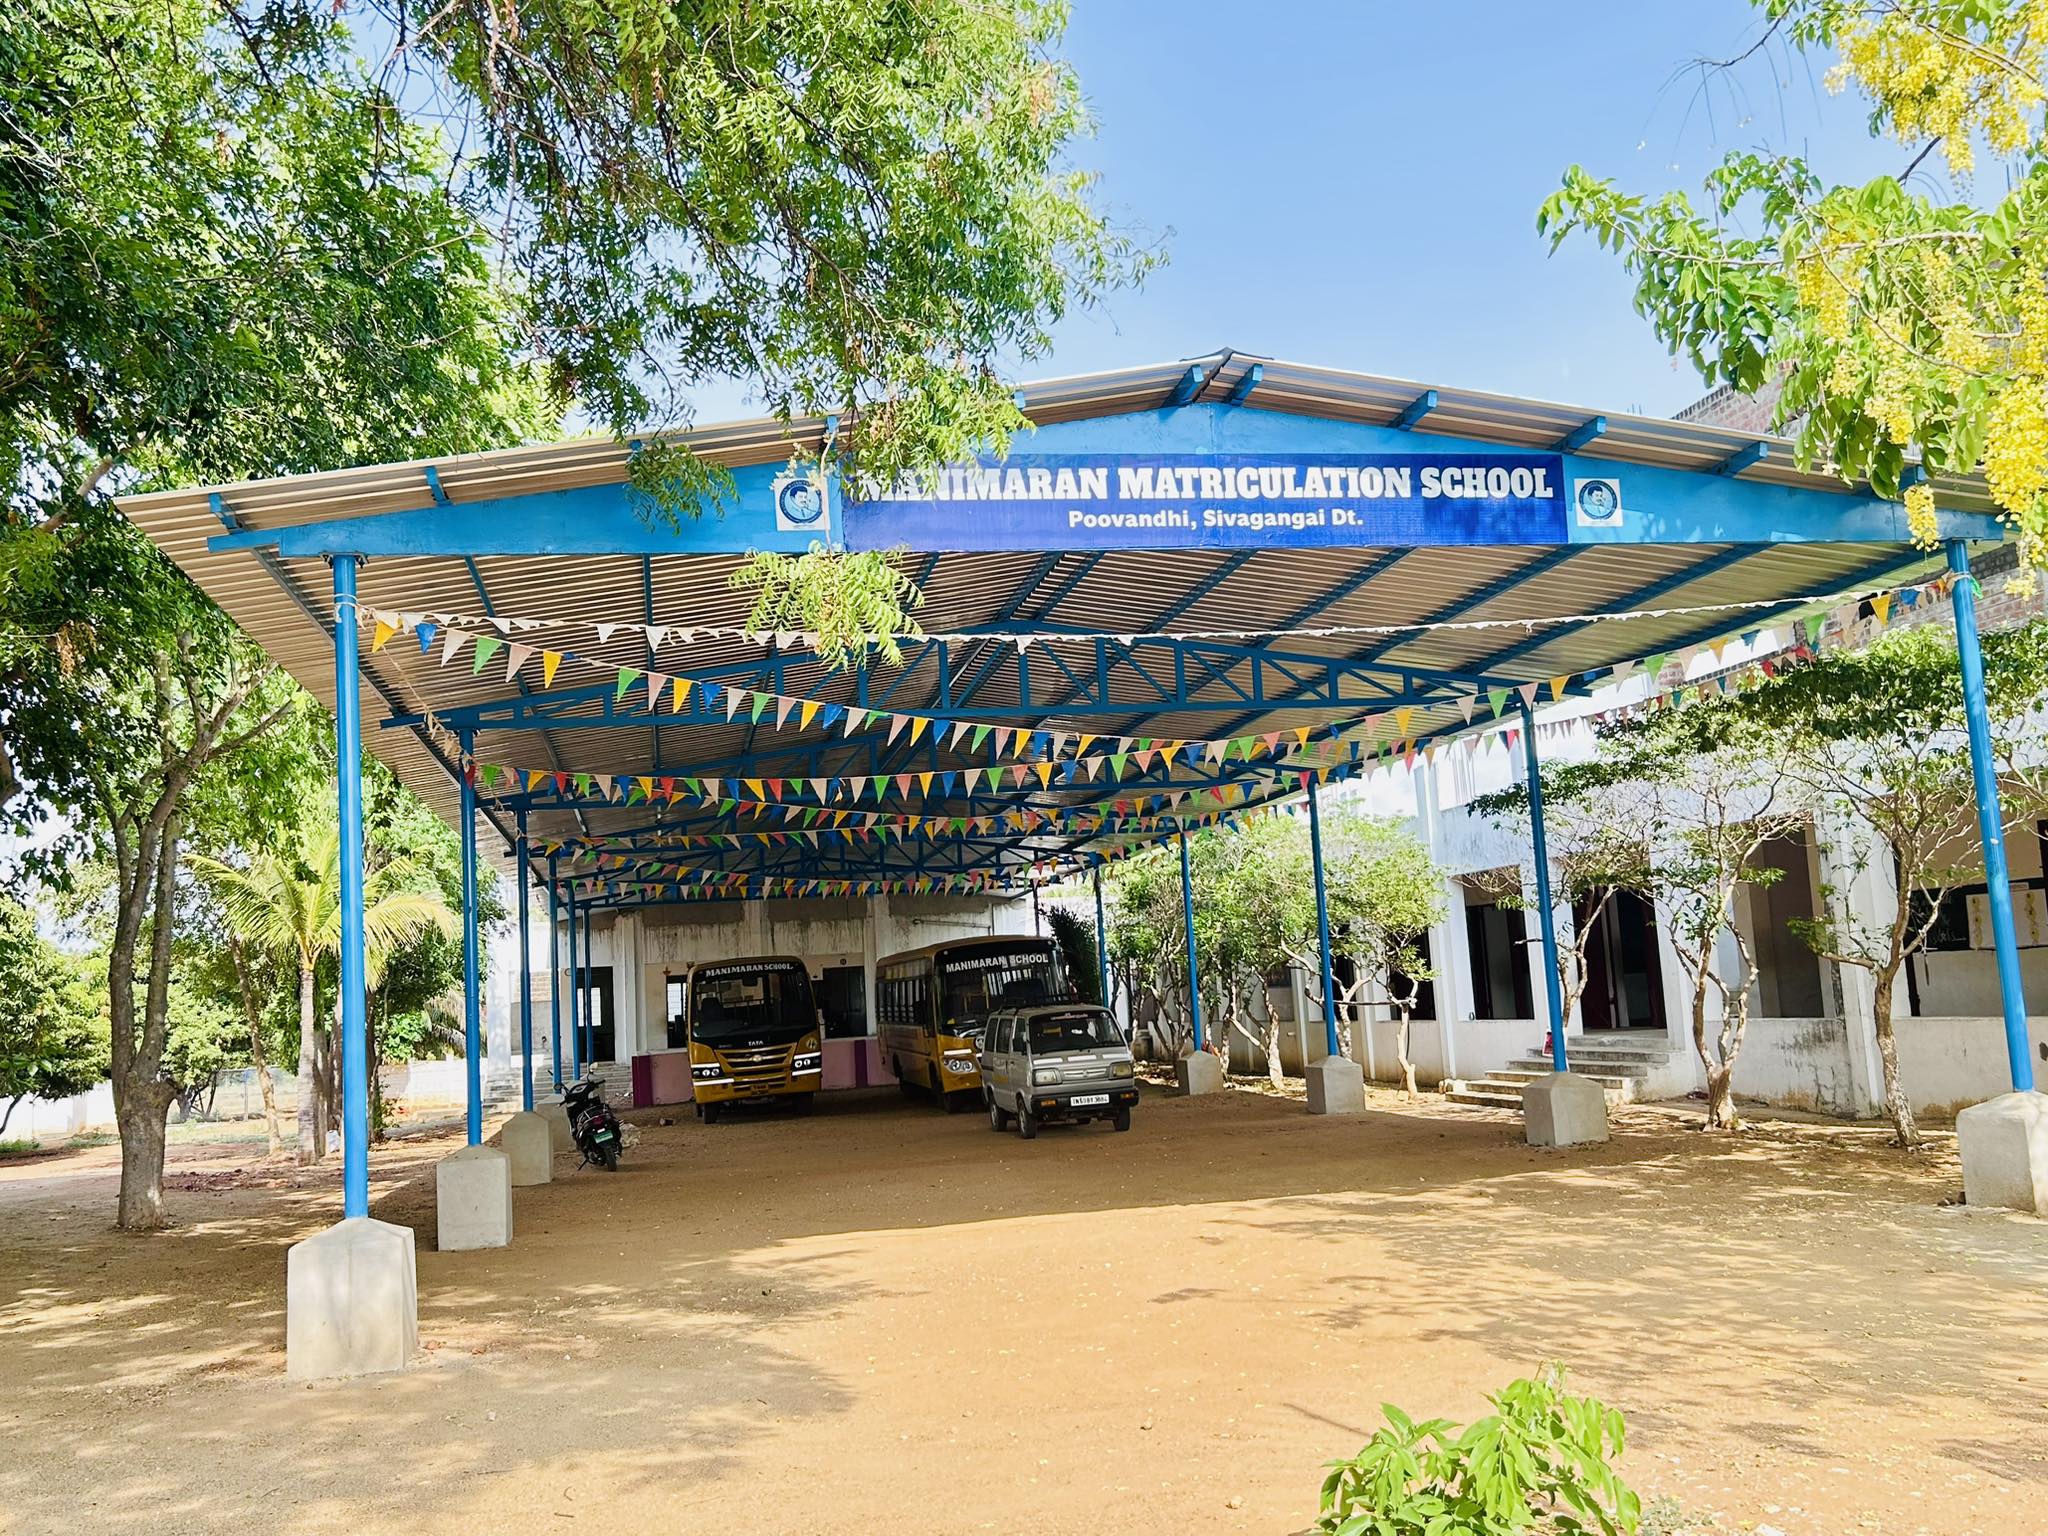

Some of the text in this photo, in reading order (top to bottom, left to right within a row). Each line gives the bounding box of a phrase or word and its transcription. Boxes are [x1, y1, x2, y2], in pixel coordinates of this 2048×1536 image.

[1117, 466, 1412, 499] MATRICULATION
[1420, 466, 1554, 499] SCHOOL
[1068, 508, 1364, 530] Poovandhi, Sivagangai Dt.
[705, 964, 763, 977] MANIMARAN
[946, 954, 1048, 973] MANIMARAN SCHOOL
